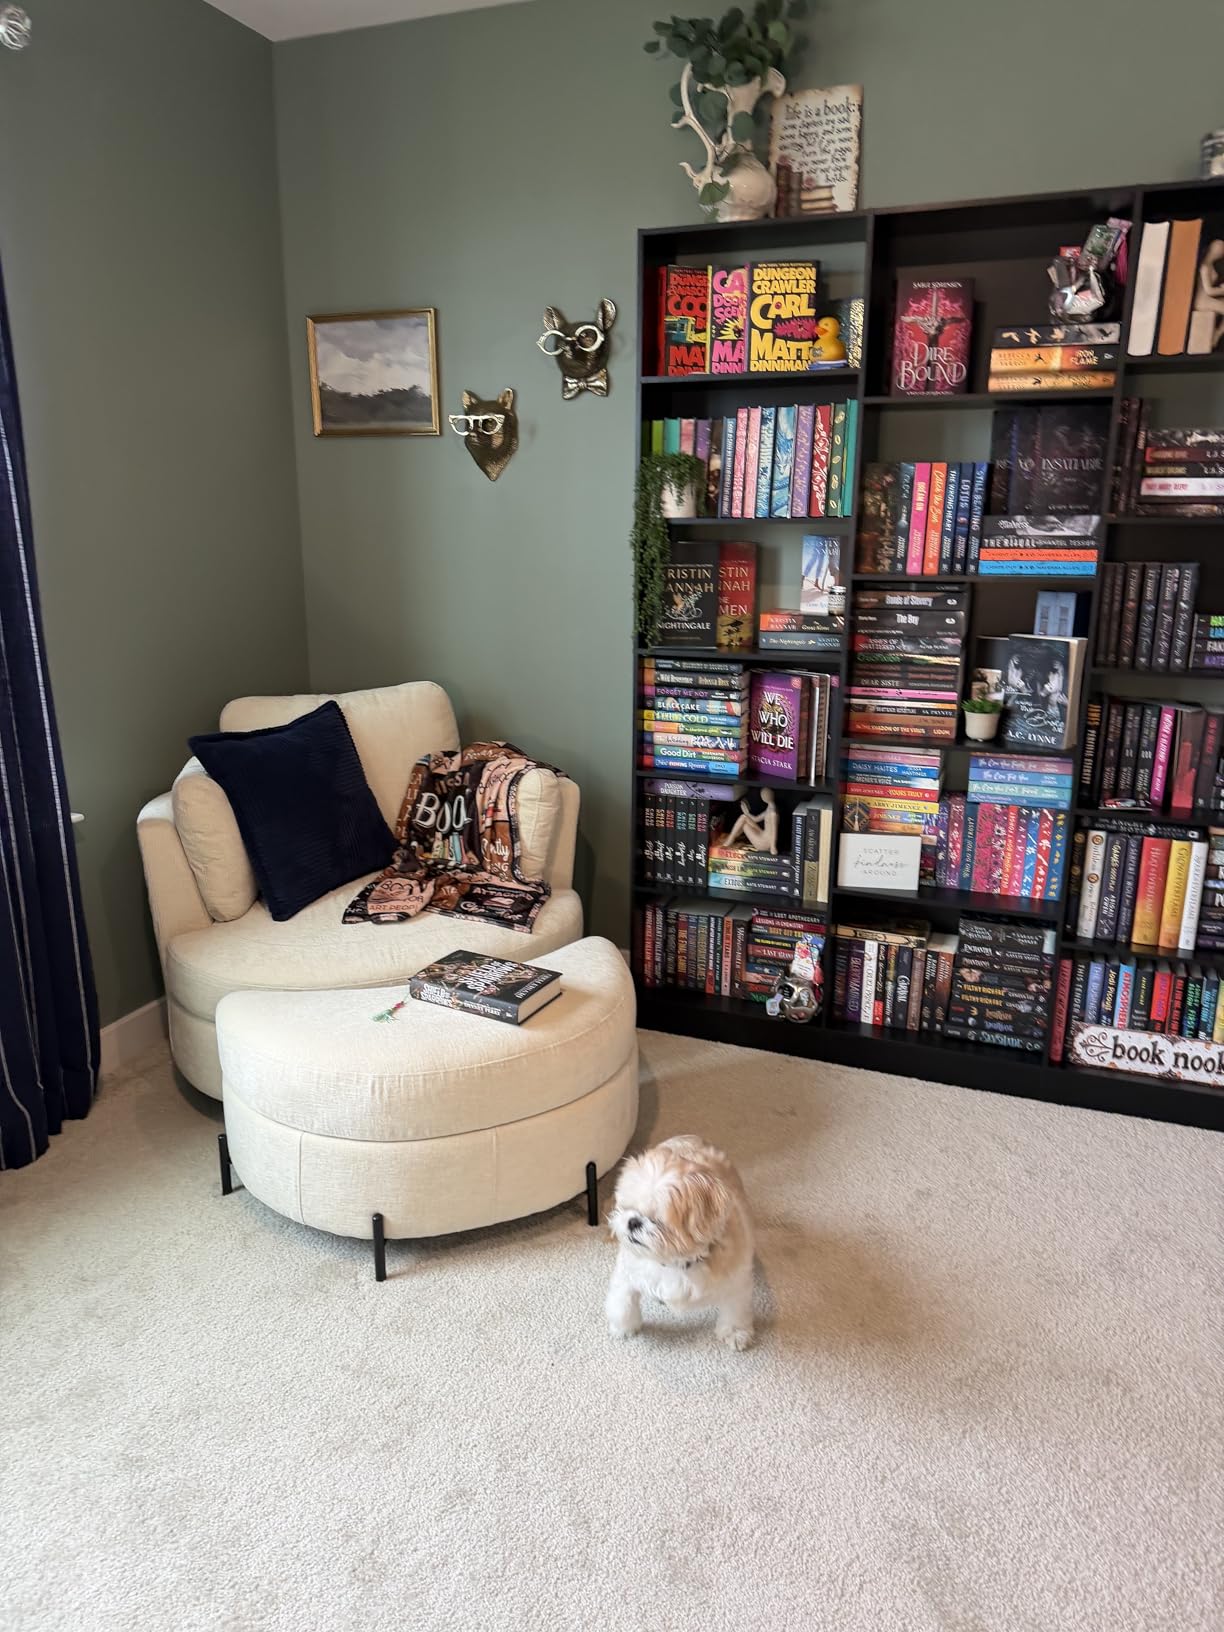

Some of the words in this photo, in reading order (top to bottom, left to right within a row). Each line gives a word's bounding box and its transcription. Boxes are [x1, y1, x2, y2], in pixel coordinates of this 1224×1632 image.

[753, 267, 816, 280] DUNGEON
[752, 280, 816, 294] CRAWLER
[750, 294, 816, 329] CARL
[751, 328, 813, 360] MATT
[910, 341, 954, 366] DIRE
[896, 360, 967, 390] BOUND
[960, 480, 971, 508] LOTUS
[662, 568, 711, 579] RISTIN
[718, 566, 749, 578] STIN
[665, 582, 714, 593] ANNAH
[719, 604, 748, 616] MEN
[657, 688, 681, 696] FORGET
[763, 691, 781, 705] WE
[683, 714, 708, 723] COLD
[758, 710, 788, 727] WHO
[750, 729, 775, 745] WILL
[777, 734, 794, 750] DIE
[660, 747, 681, 756] Good
[682, 749, 696, 758] Dirt
[660, 788, 687, 796] DAUGHTER
[412, 792, 473, 834] BOO
[1076, 964, 1085, 981] THIS
[1113, 1035, 1166, 1066] book
